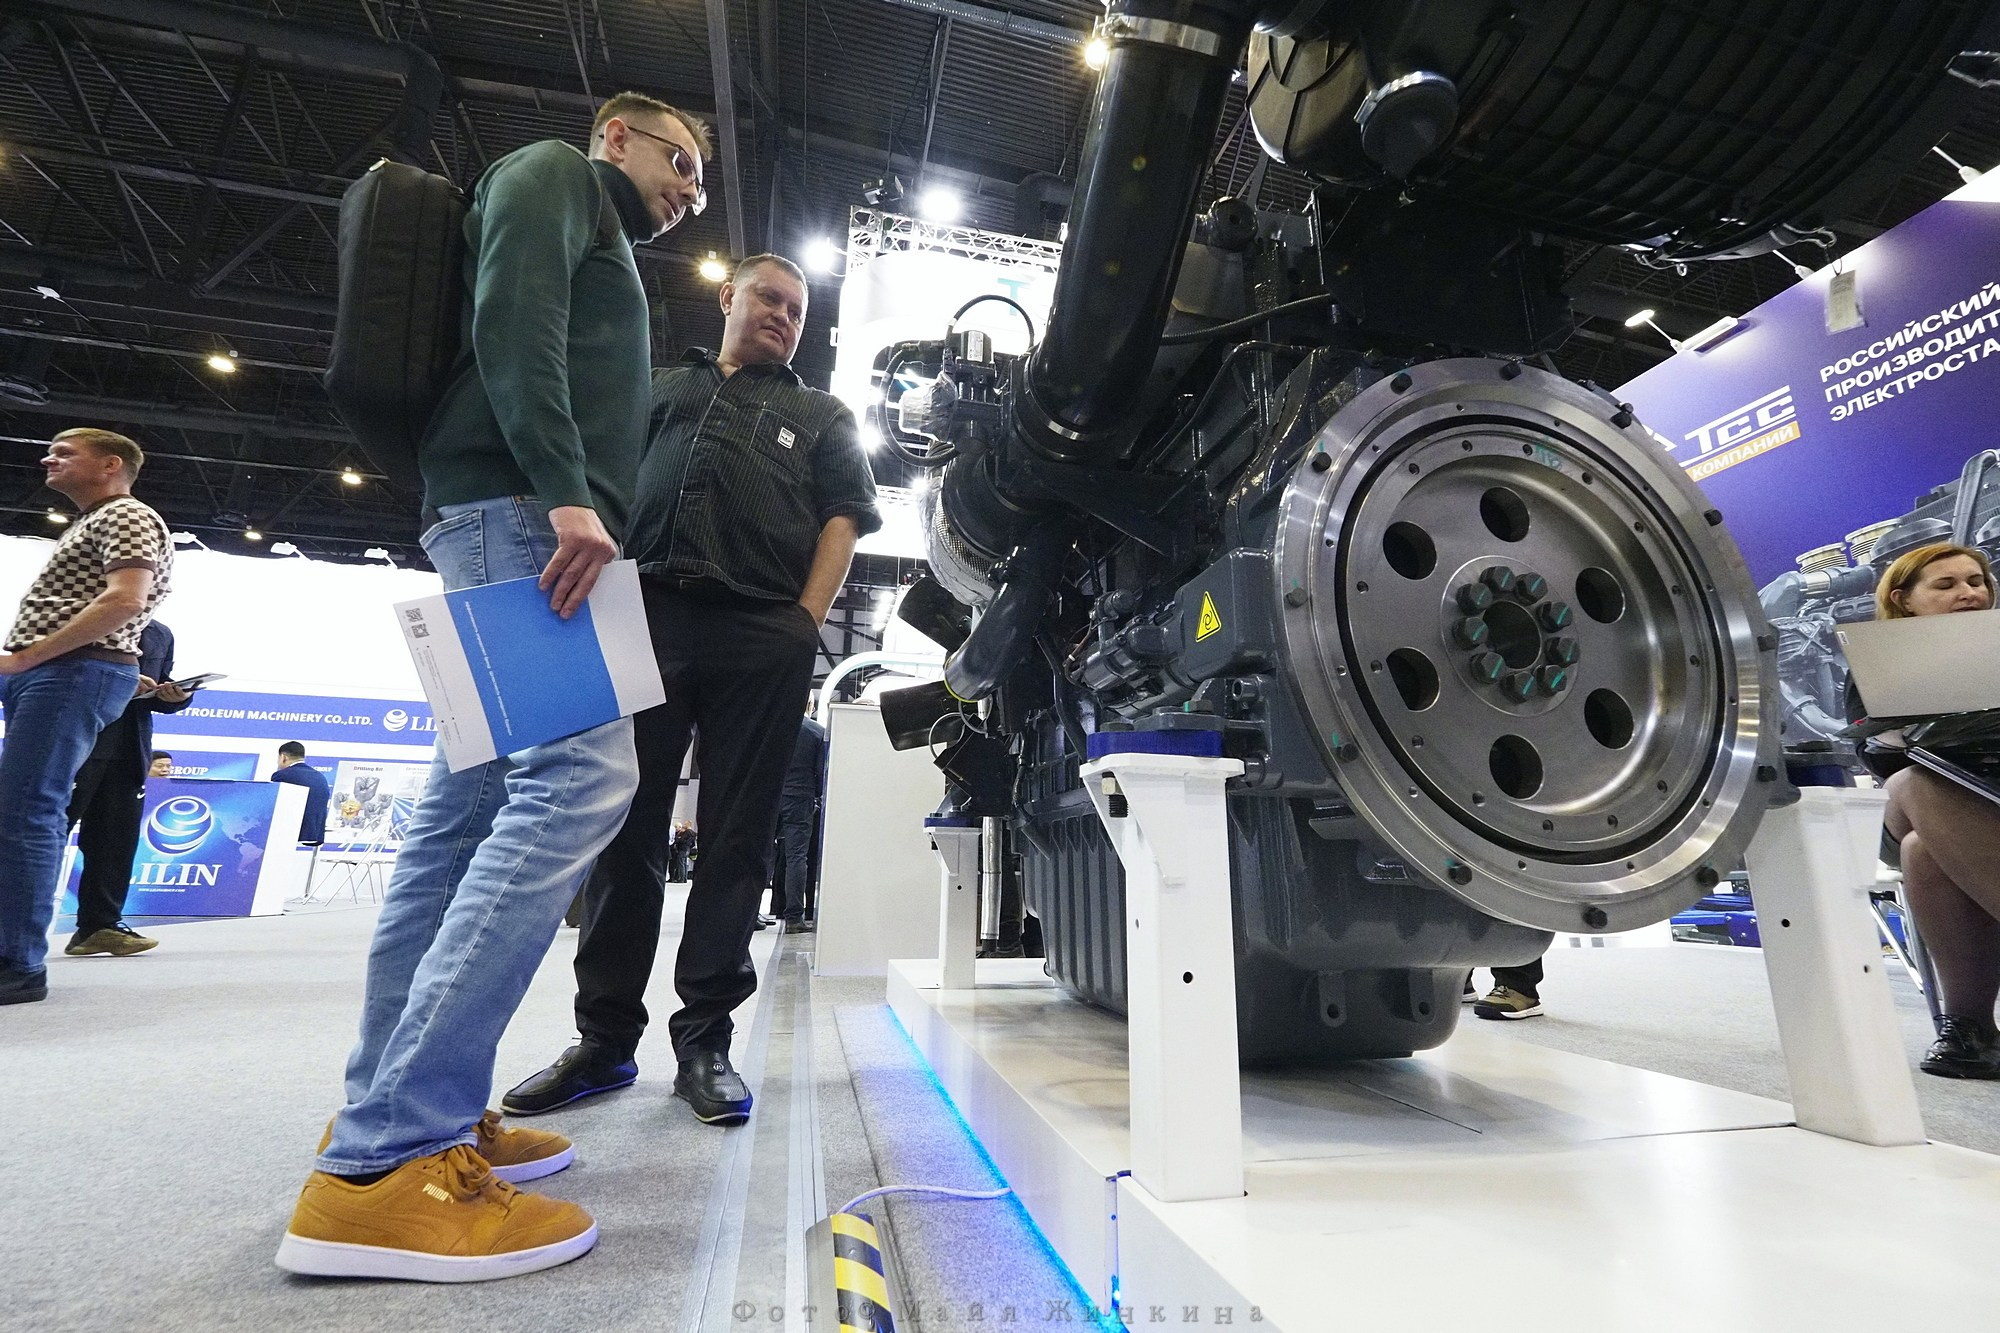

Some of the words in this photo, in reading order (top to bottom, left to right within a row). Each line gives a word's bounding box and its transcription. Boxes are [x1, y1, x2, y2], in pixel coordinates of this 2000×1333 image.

[1820, 282, 2000, 383] РОССИЙСКИЙ
[175, 707, 245, 719] ETROLEUM
[247, 710, 323, 723] MACHINERY
[129, 862, 223, 887] ILIN
